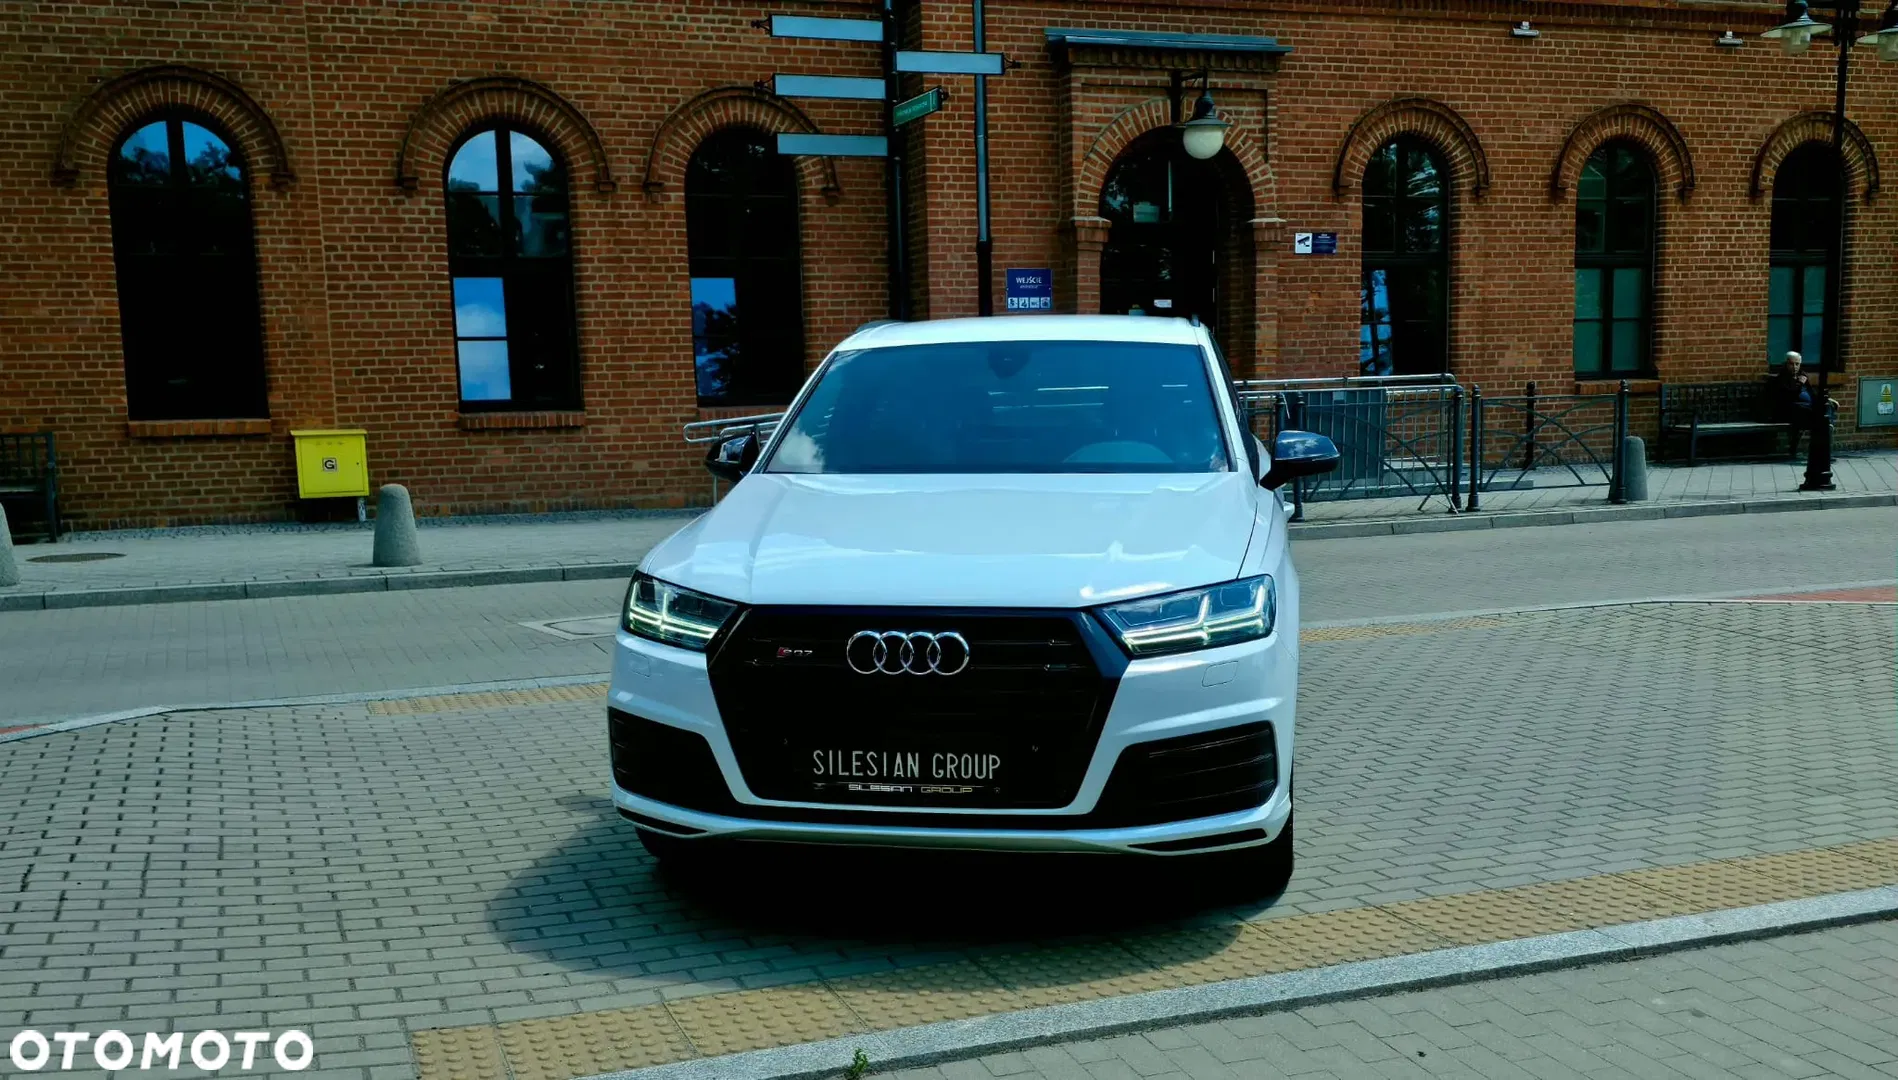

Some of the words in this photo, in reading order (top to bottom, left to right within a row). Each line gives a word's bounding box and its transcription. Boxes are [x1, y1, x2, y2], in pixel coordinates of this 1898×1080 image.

[324, 459, 335, 470] G
[813, 749, 919, 778] SILESIAN
[932, 752, 1001, 780] GROUP
[920, 785, 973, 794] GROUP
